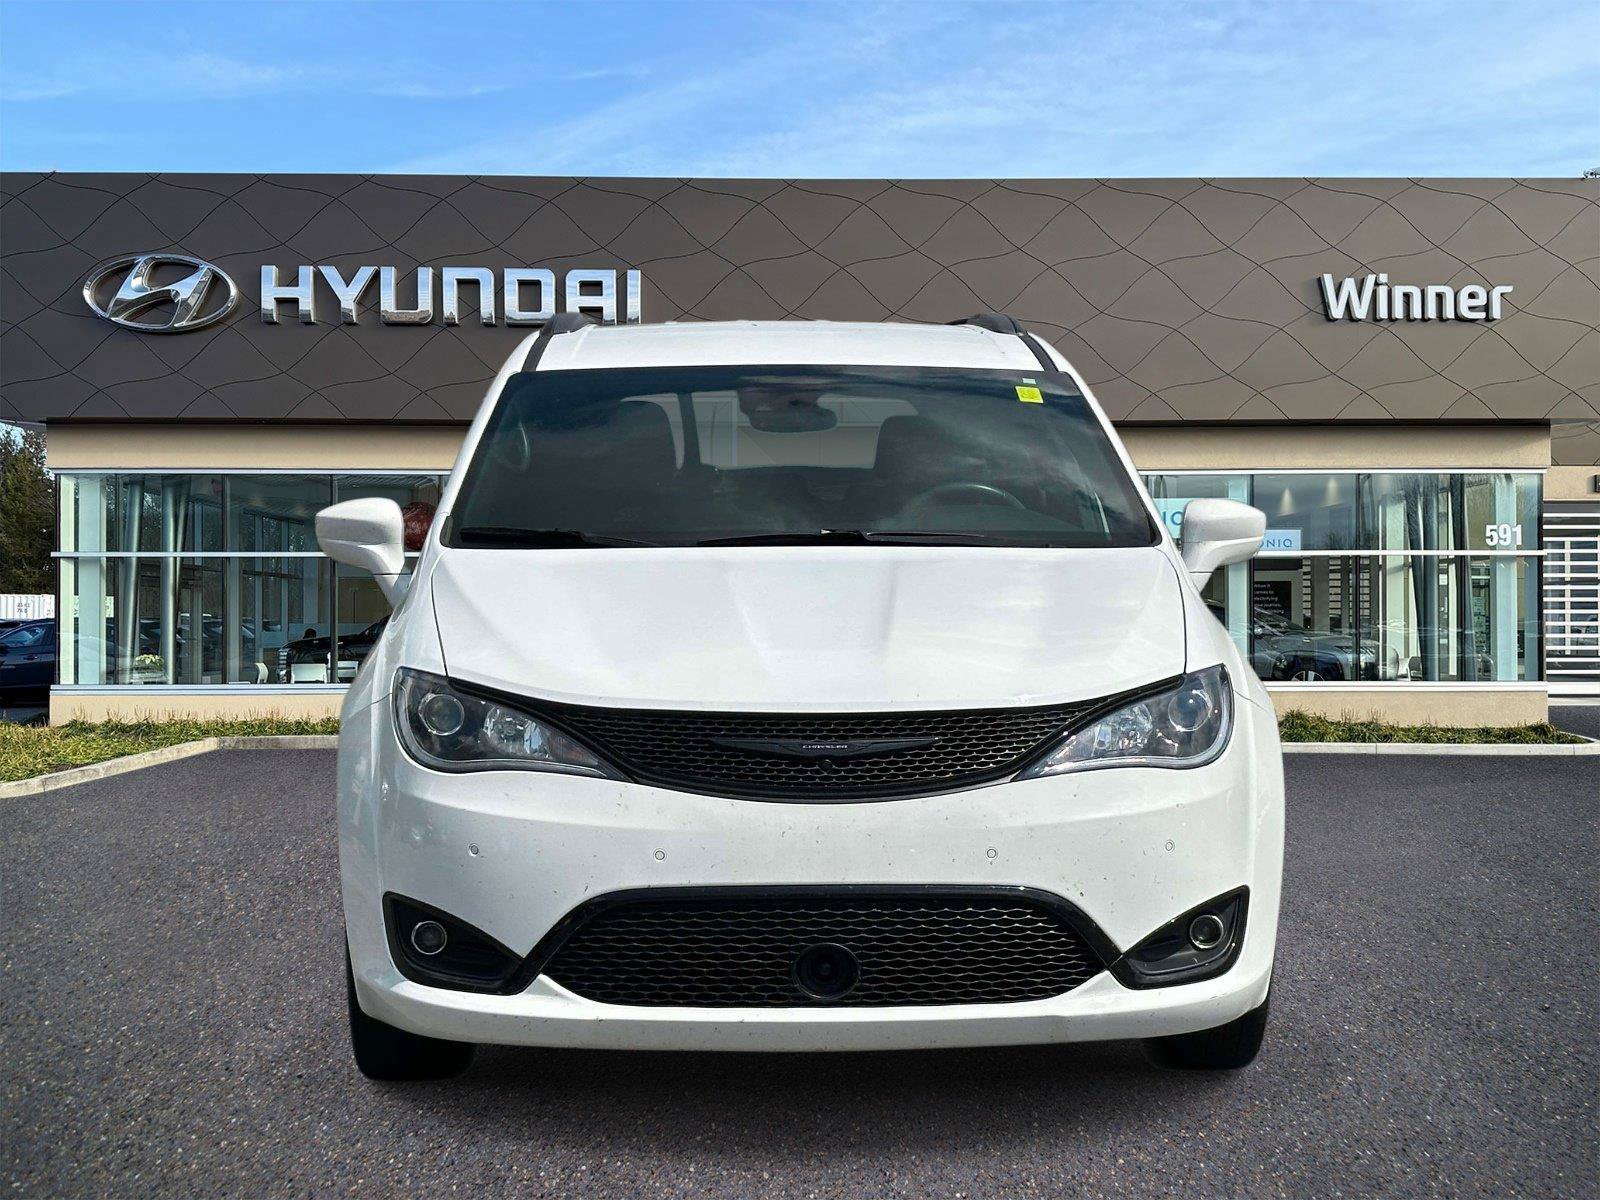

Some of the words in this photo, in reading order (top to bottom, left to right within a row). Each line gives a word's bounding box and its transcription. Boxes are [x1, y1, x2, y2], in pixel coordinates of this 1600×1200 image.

[260, 264, 642, 326] HYUNDAI
[1320, 272, 1514, 321] Winner
[1484, 523, 1523, 547] 591
